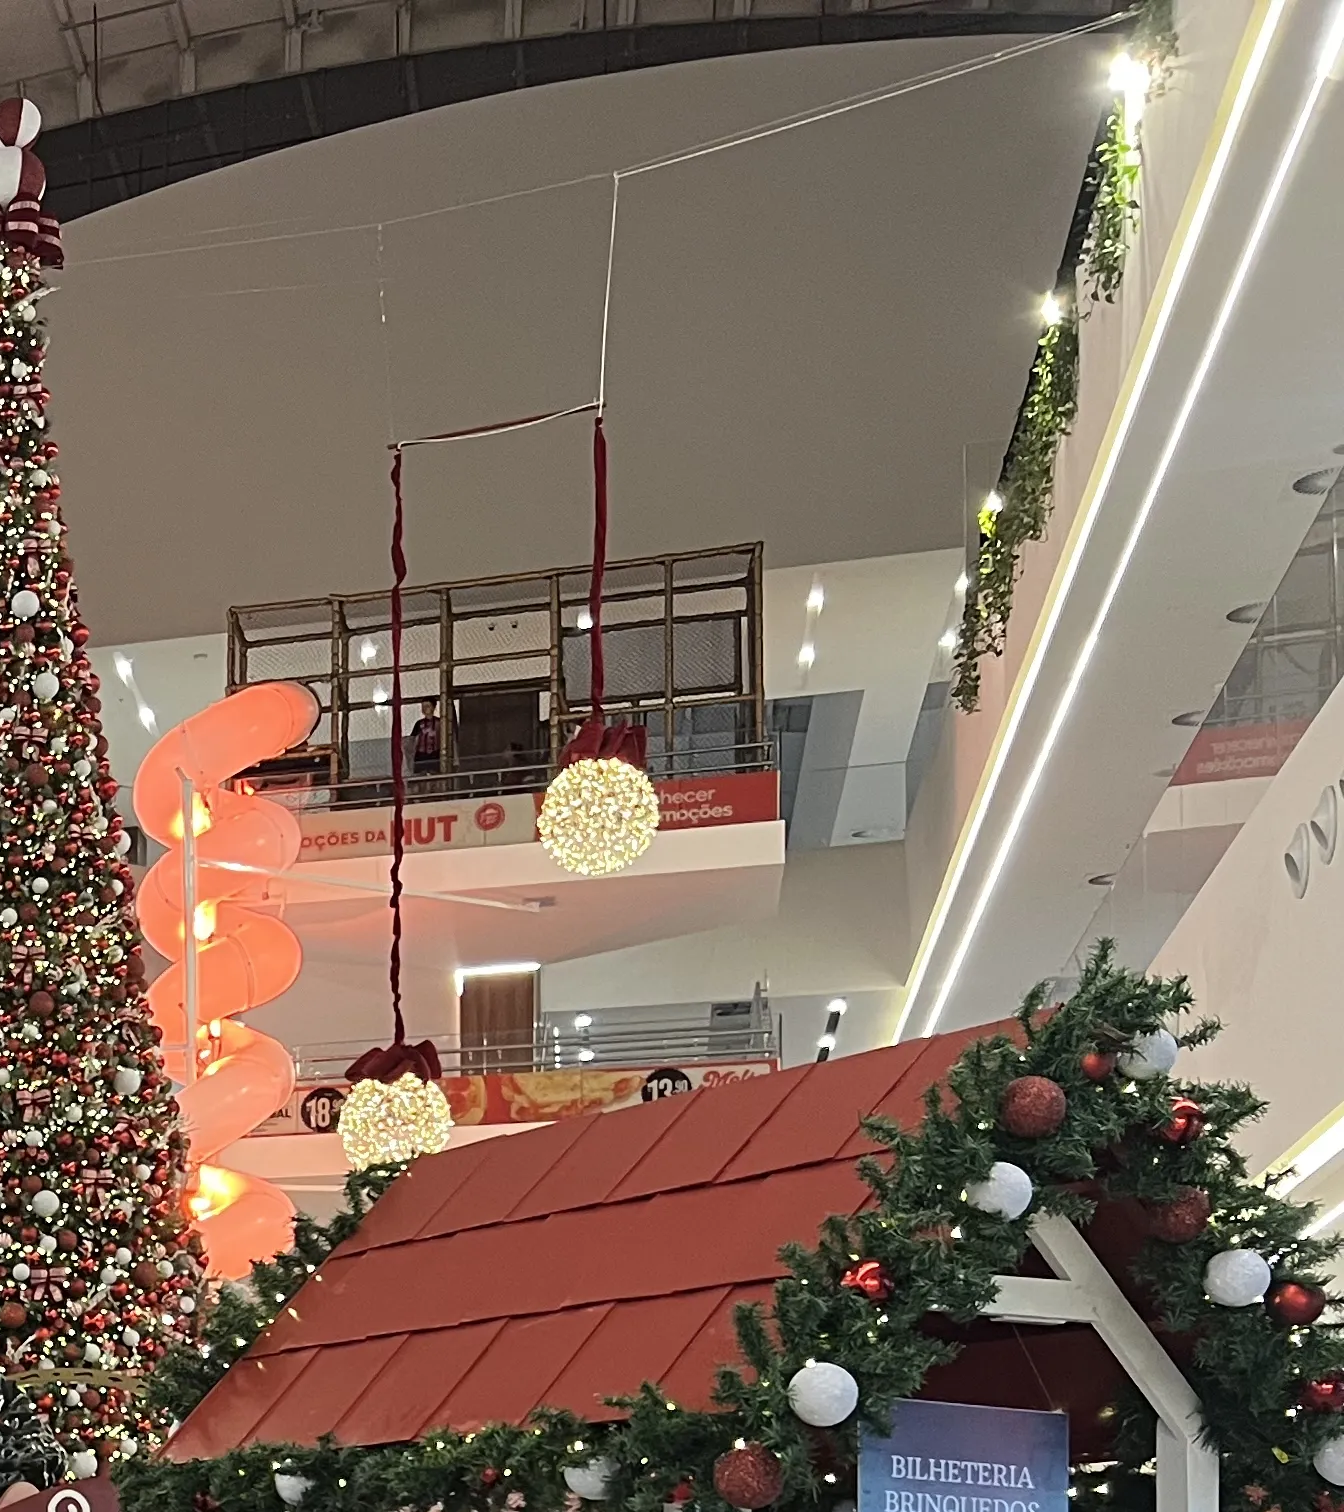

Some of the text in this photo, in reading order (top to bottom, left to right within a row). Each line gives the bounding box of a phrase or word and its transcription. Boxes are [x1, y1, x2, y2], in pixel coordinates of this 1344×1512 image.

[660, 788, 716, 804] hecer
[661, 804, 733, 824] moções
[301, 830, 359, 850] OÇÕES
[365, 830, 386, 842] DA
[891, 1455, 1035, 1489] BILHETERIA
